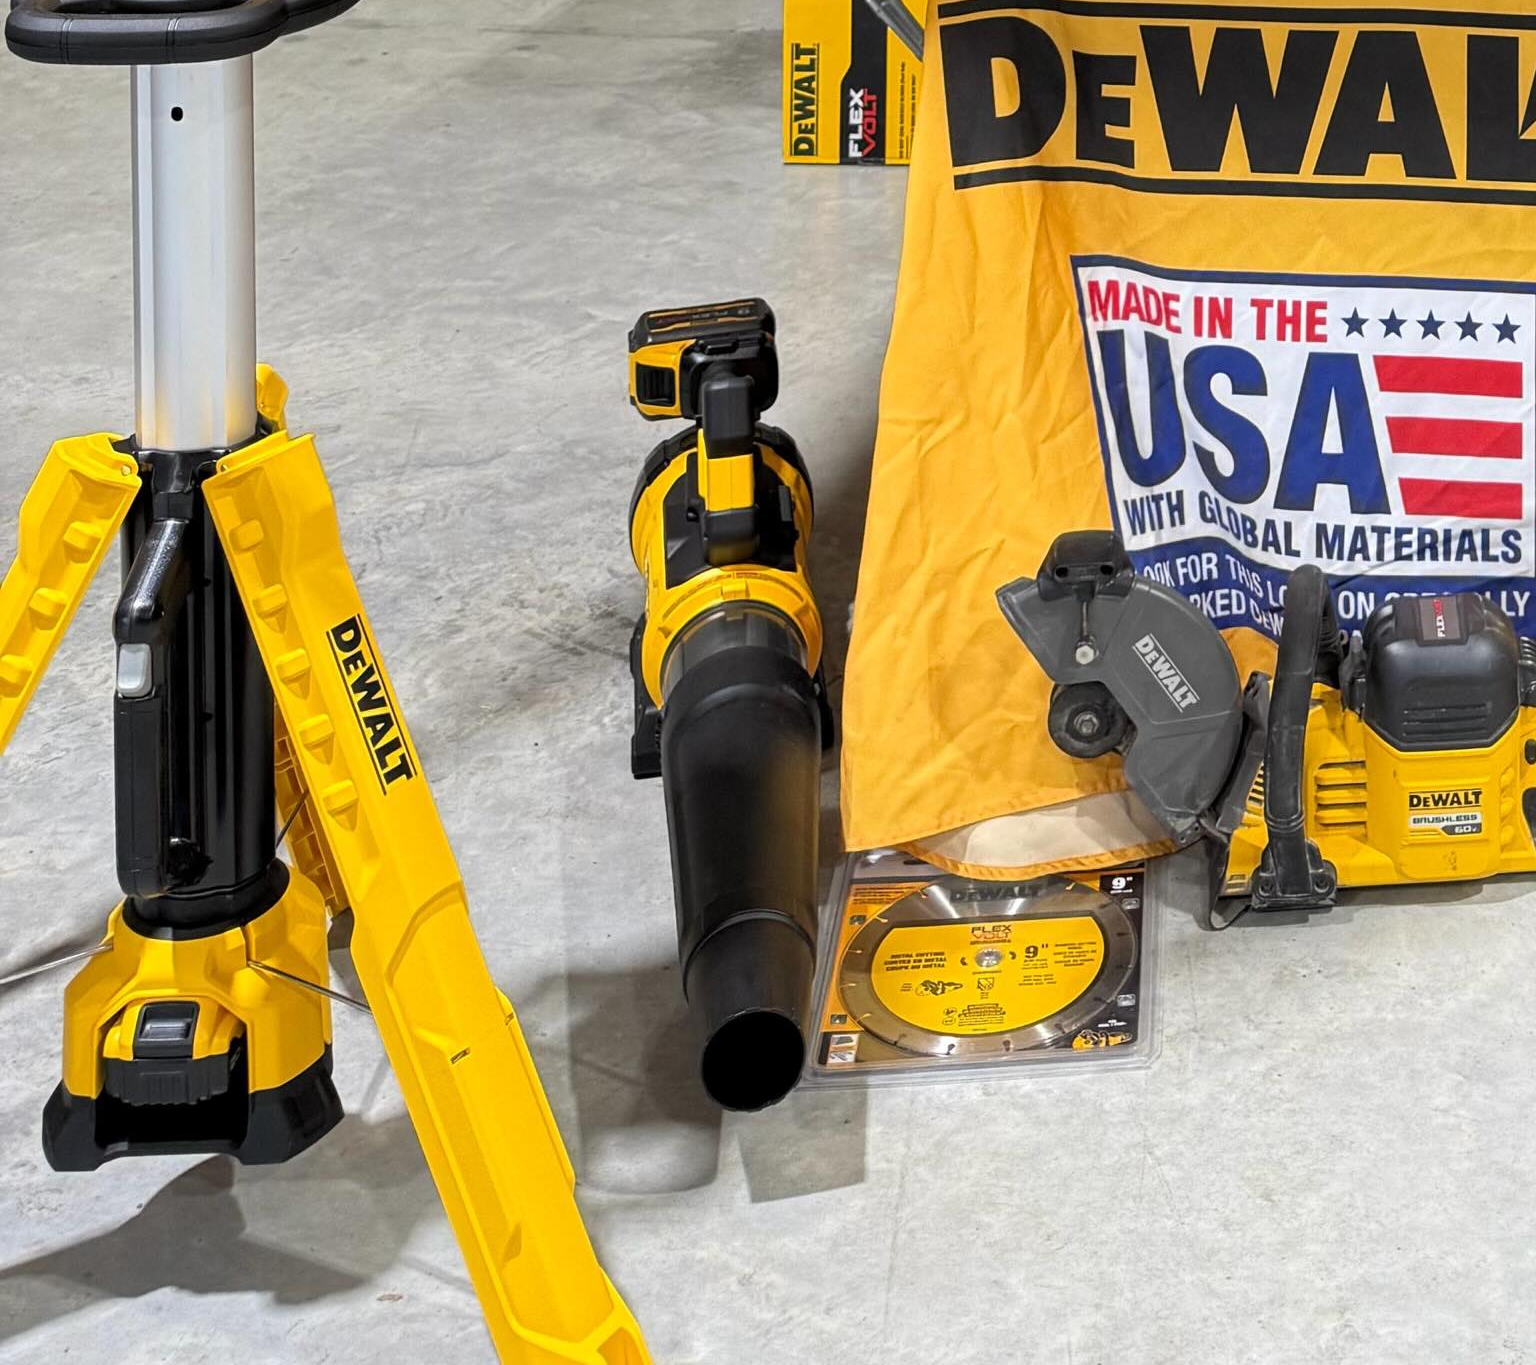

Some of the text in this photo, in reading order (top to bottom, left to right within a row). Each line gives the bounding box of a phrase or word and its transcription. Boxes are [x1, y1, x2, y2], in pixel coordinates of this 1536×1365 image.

[793, 43, 817, 156] DEWALT
[848, 88, 864, 158] FLEX
[862, 87, 877, 157] VOLT
[1088, 280, 1328, 343] MADE IN THE
[1096, 328, 1392, 516] USA
[1123, 490, 1523, 564] WITH GLOBAL MATERIALS
[1175, 552, 1218, 586] FOR
[1225, 554, 1264, 597] THIS
[1337, 590, 1375, 620] ON
[331, 615, 414, 785] DEWALT
[1134, 635, 1198, 709] DEWALT
[1409, 790, 1482, 809] DEWALT
[1412, 814, 1477, 824] BRUSHLESS
[971, 924, 1012, 934] FLEX
[972, 932, 1010, 940] VOLT
